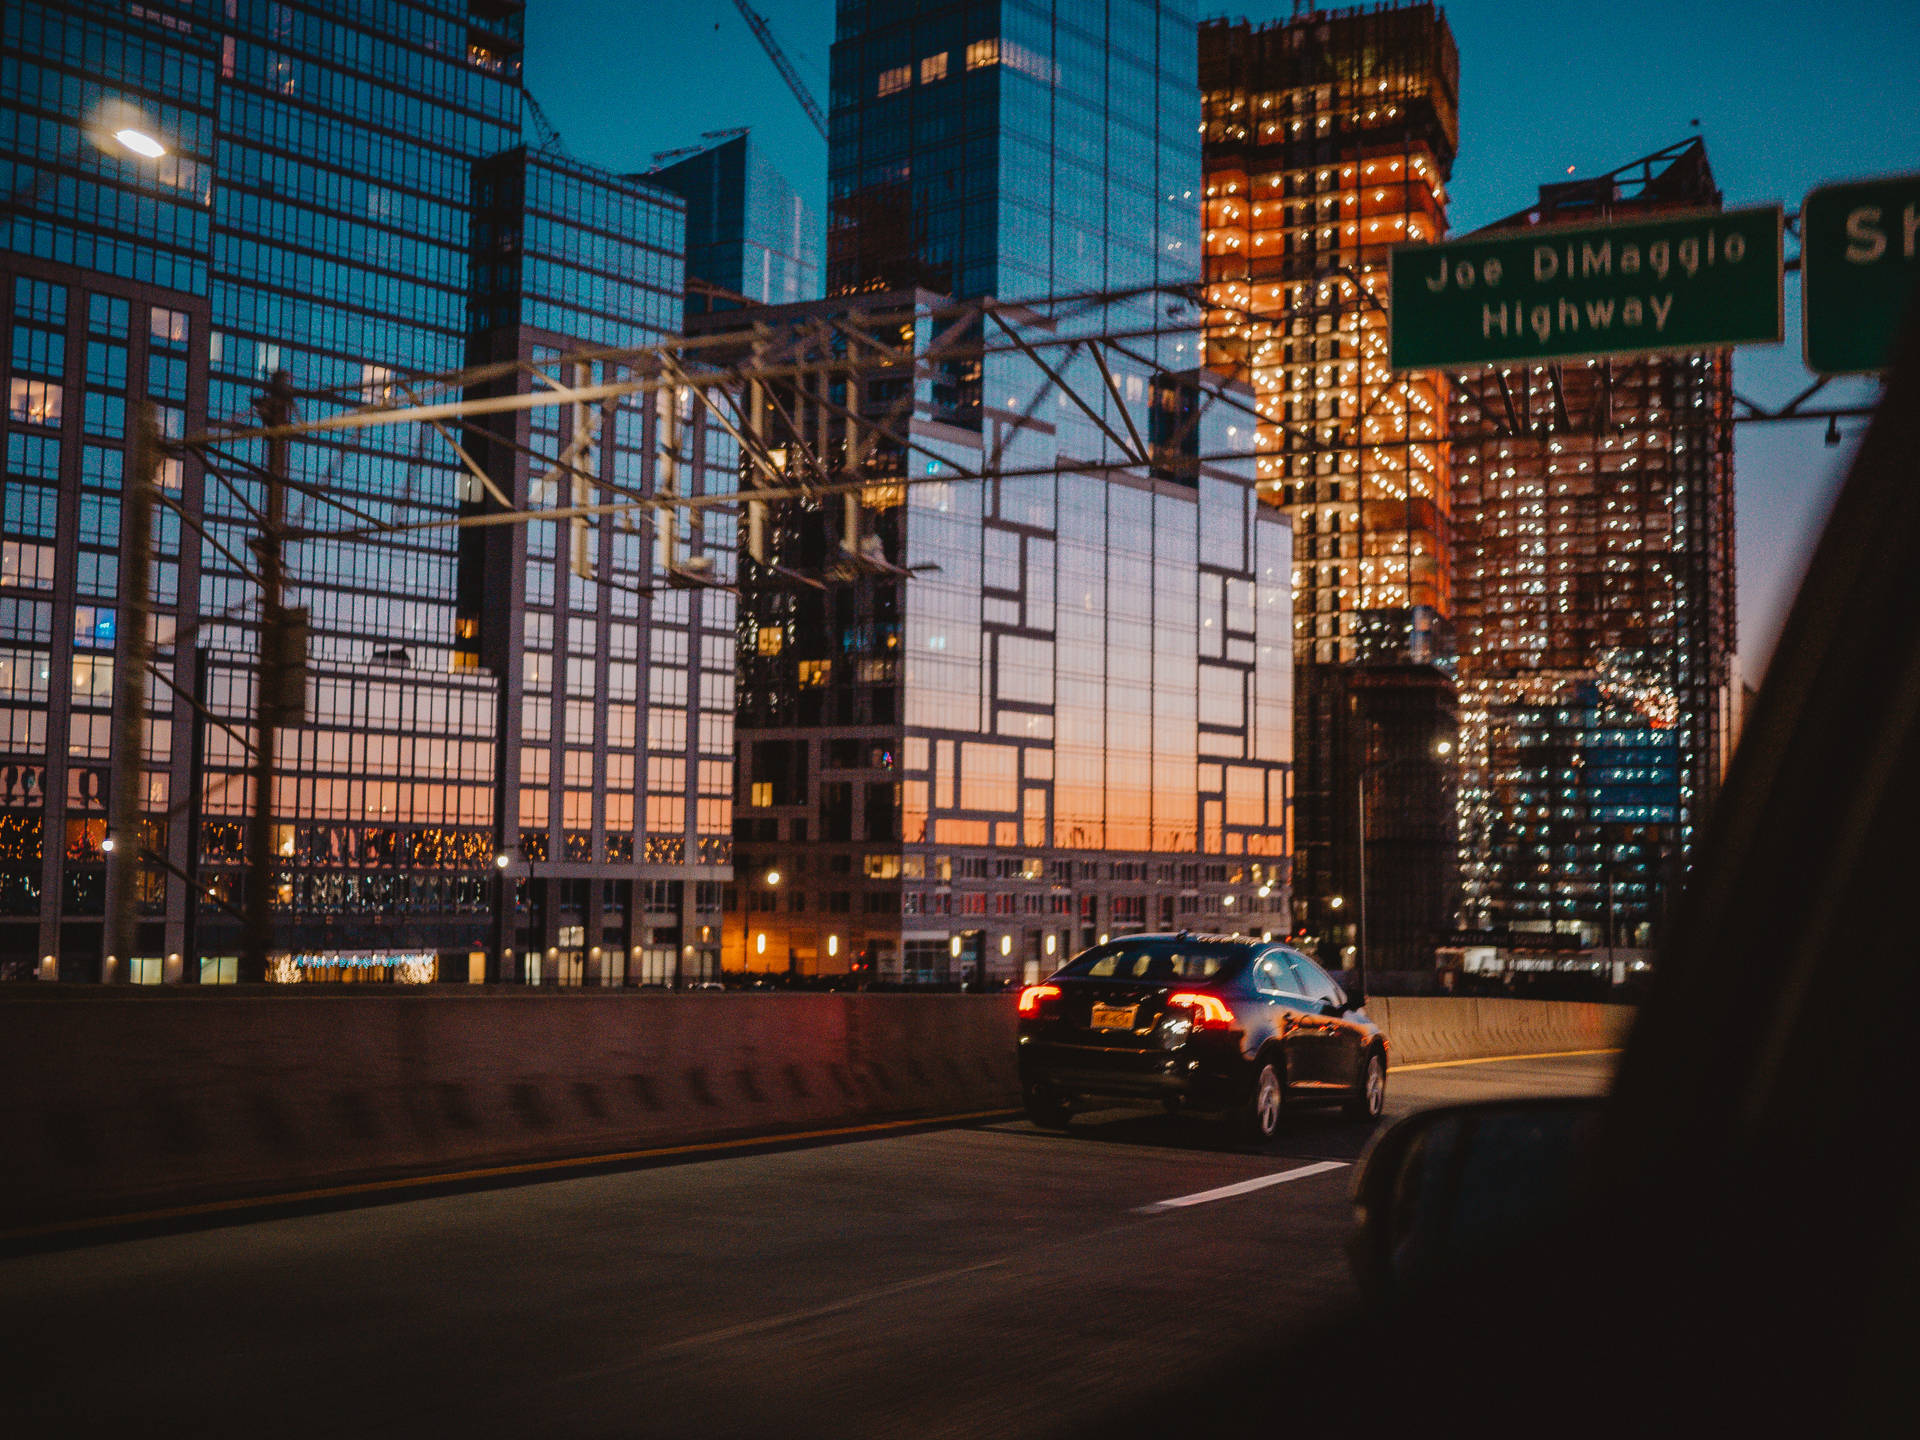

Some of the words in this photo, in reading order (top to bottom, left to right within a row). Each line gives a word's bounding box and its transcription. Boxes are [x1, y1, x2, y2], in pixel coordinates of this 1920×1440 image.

[1425, 256, 1503, 292] Joe
[1533, 228, 1746, 282] DiMaggio
[1482, 291, 1673, 345] Highway
